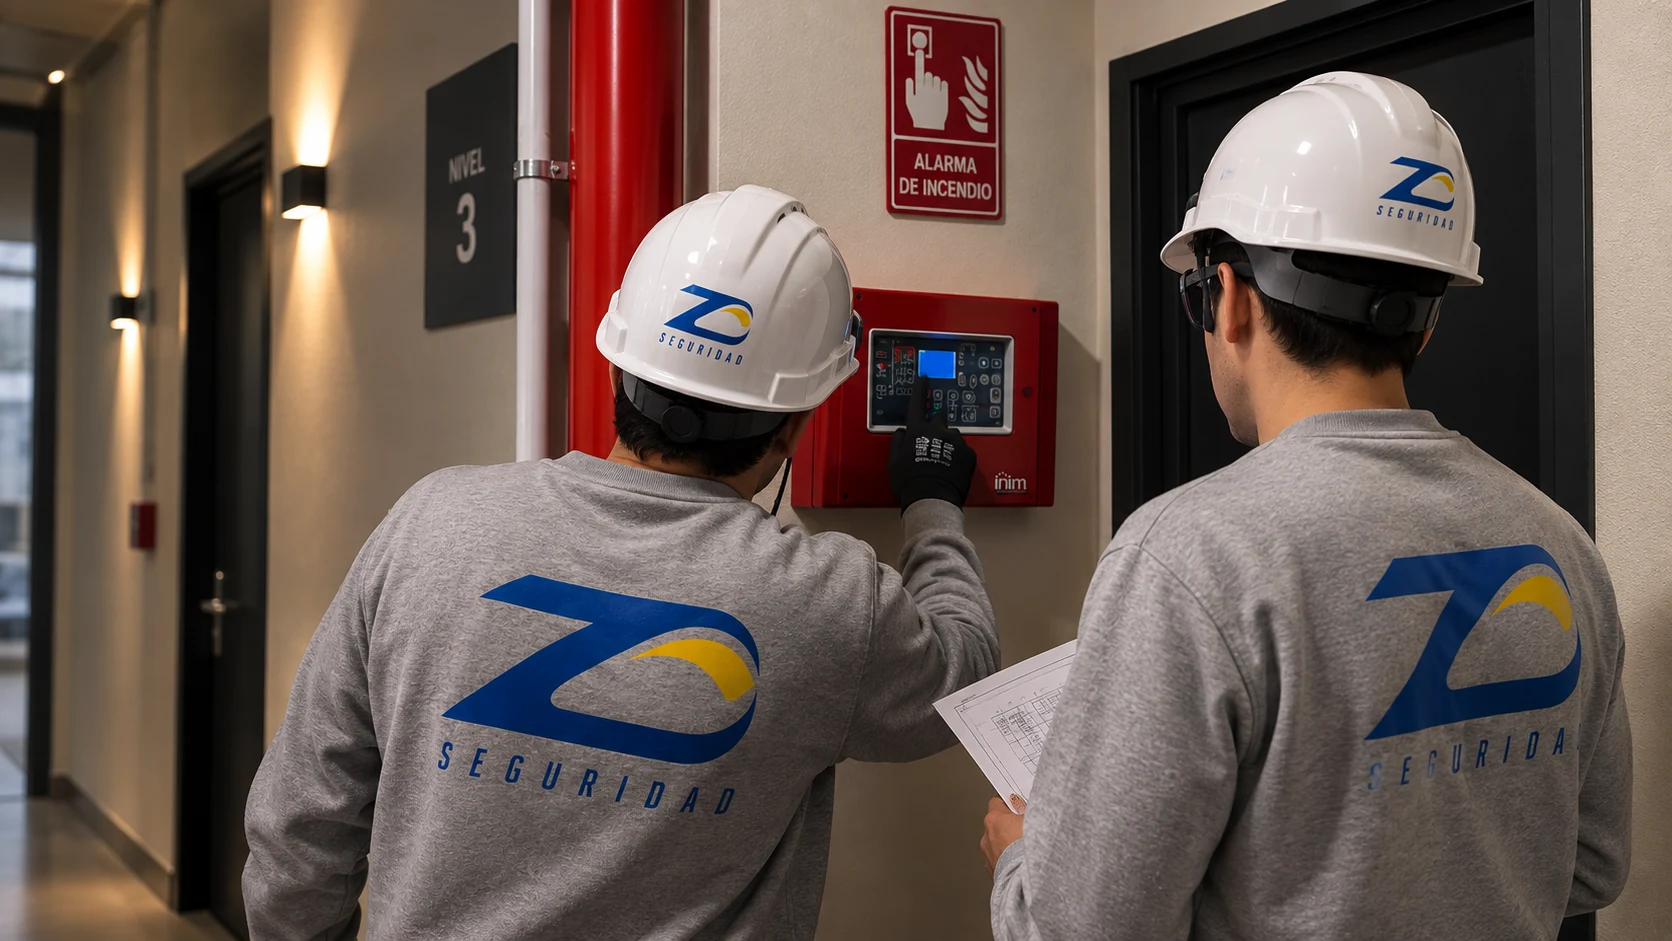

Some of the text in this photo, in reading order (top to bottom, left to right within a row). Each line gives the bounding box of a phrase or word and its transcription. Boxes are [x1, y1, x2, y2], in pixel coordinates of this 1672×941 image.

[448, 147, 486, 184] NIVEL
[914, 152, 977, 174] ALARMA
[899, 176, 992, 200] DE INCENDIO
[456, 192, 477, 264] 3
[1376, 205, 1454, 231] SEGURIDAD
[658, 332, 743, 366] SEGURIDAD
[994, 473, 1027, 490] inim
[1367, 723, 1582, 791] SEGURIDA
[437, 742, 735, 815] SEGURIDAD
